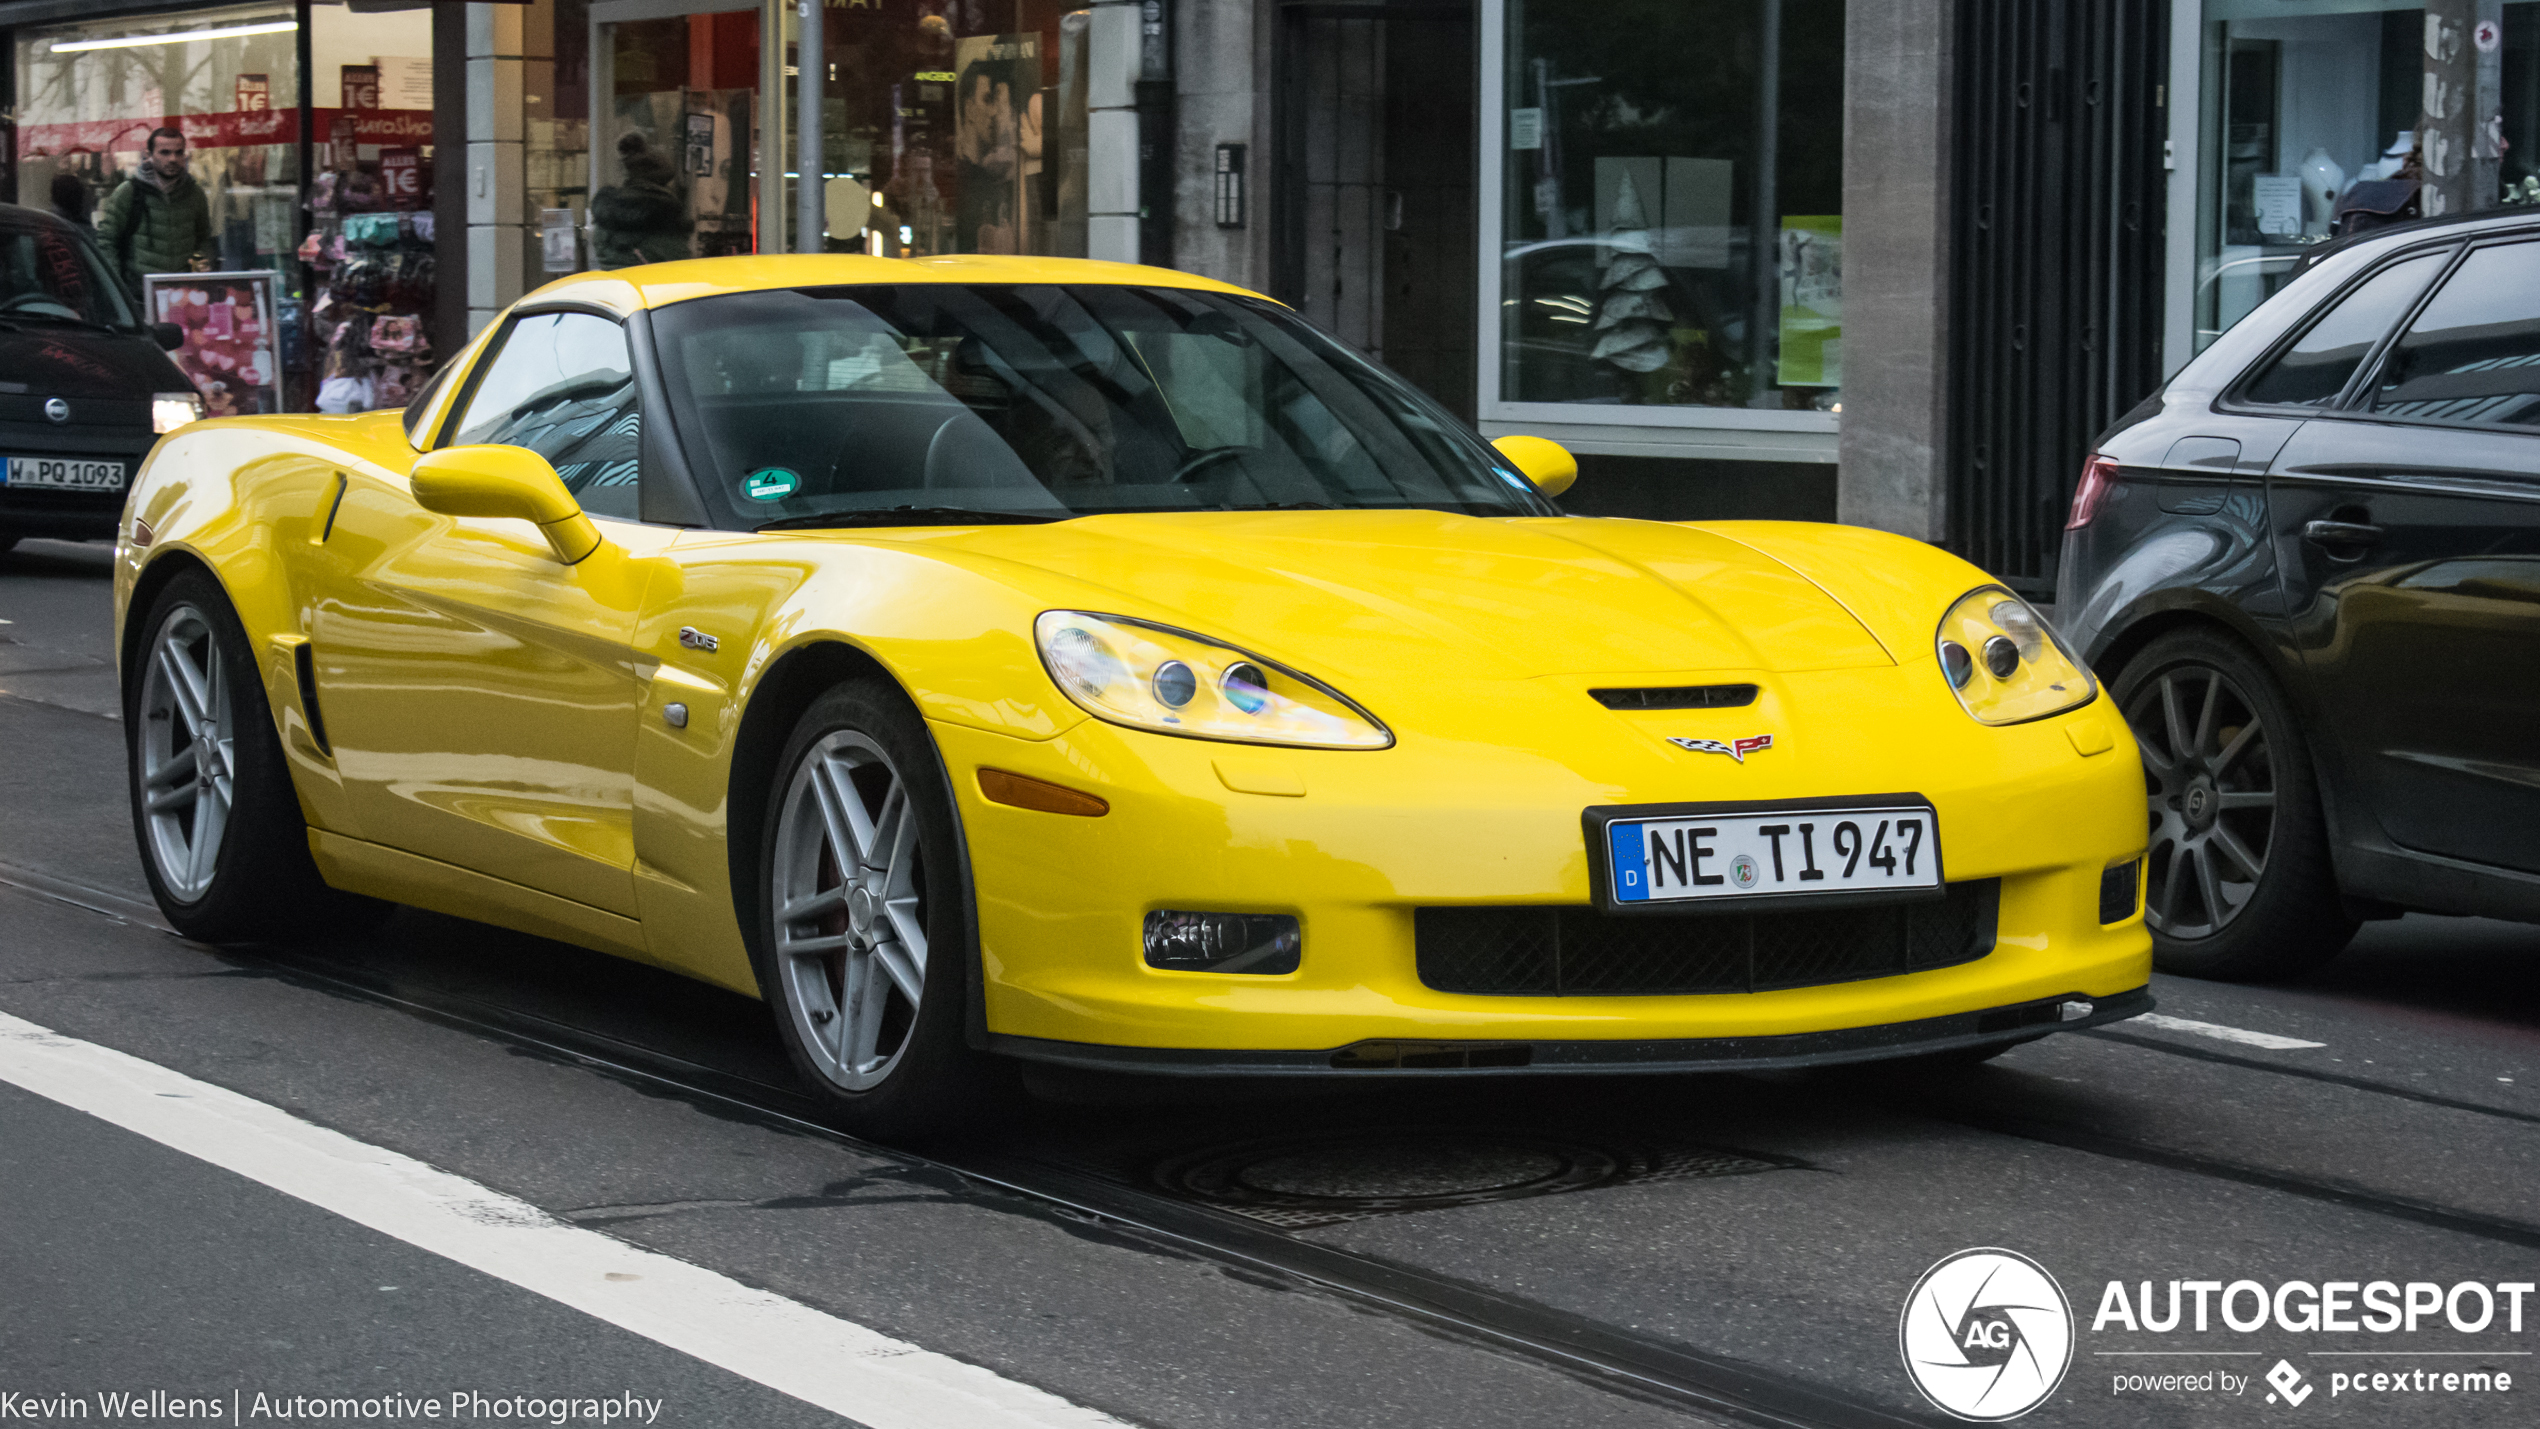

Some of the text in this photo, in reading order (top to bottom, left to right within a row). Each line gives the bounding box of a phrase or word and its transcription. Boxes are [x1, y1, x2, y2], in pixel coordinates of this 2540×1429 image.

[238, 93, 267, 112] 1€
[344, 85, 377, 109] 1€
[383, 168, 419, 195] 1€
[10, 460, 122, 486] W PQ 1093
[763, 472, 778, 485] 4
[1650, 818, 1923, 888] NE TI 947
[1625, 869, 1638, 887] D
